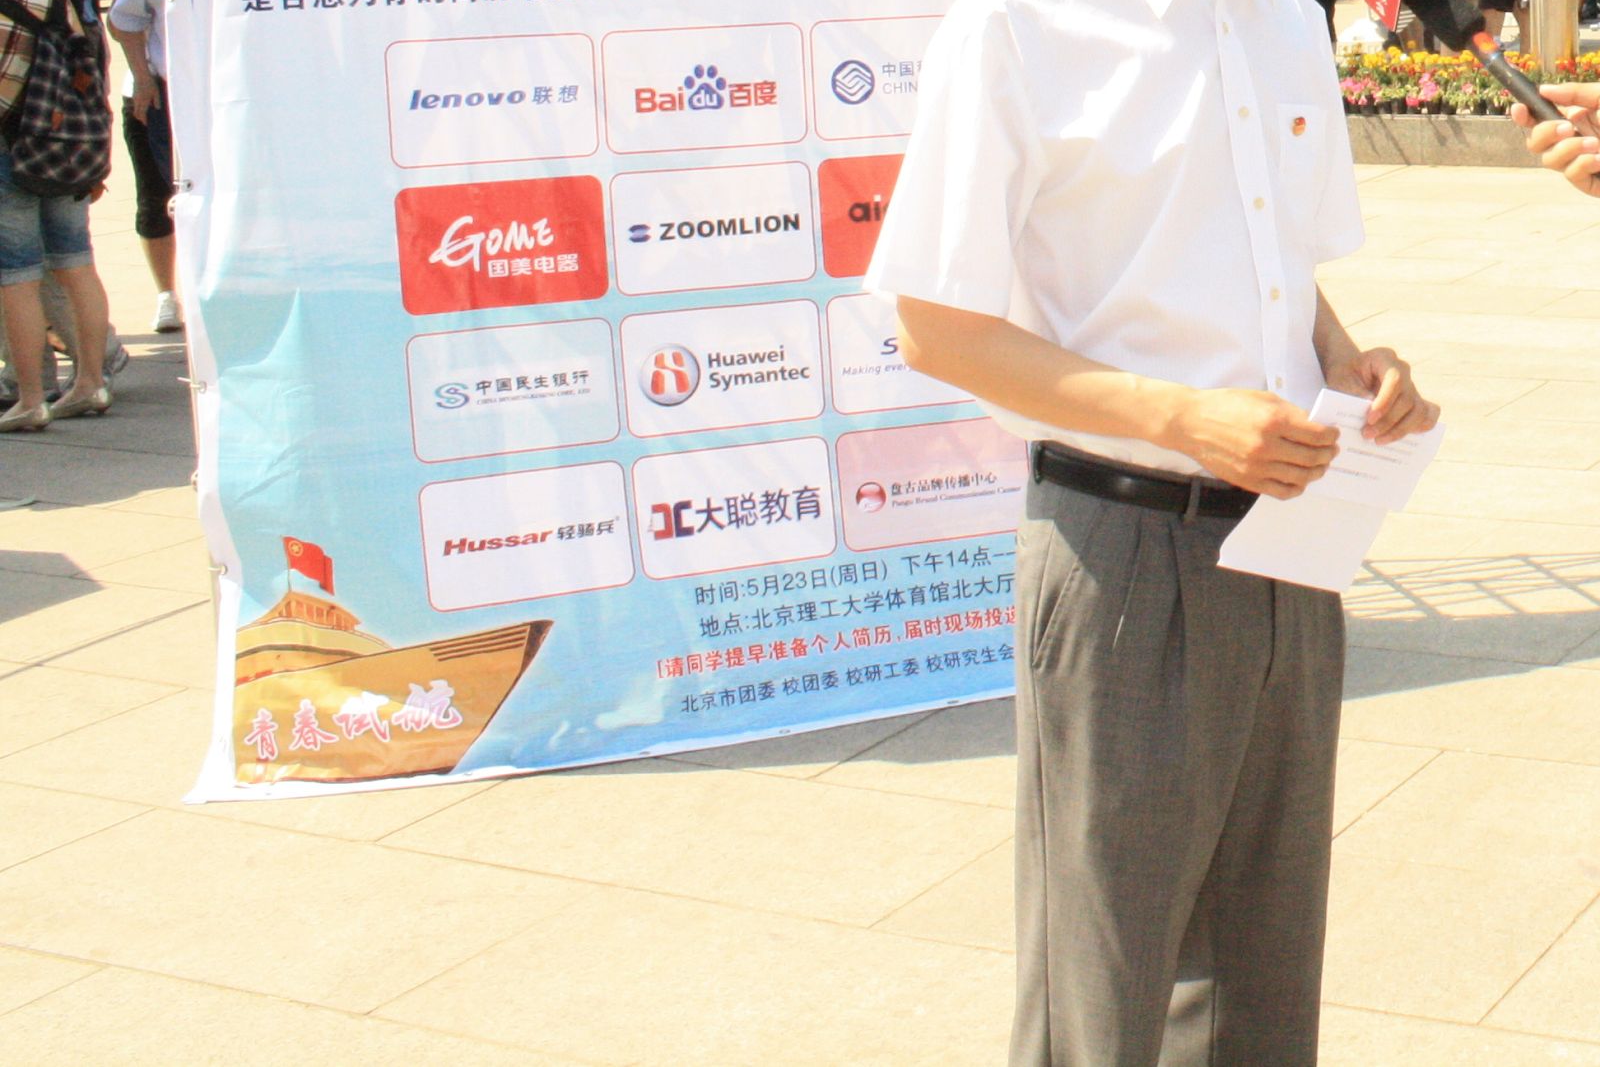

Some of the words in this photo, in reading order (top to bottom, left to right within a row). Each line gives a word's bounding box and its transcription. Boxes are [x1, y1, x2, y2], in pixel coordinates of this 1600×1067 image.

[409, 87, 526, 111] lenovo
[531, 84, 580, 105] 联想
[728, 80, 778, 108] 百度
[659, 213, 800, 243] ZOOMLION
[487, 253, 579, 278] 国美电器
[707, 345, 785, 367] Huawei
[842, 363, 881, 375] Making
[475, 370, 590, 396] 中国民生银行
[708, 365, 811, 390] Symantec
[891, 472, 997, 496] 盘古品牌传播中心
[695, 485, 822, 534] 大聪教育
[442, 529, 553, 557] Hussar
[556, 519, 616, 542] 轻骑兵
[681, 682, 776, 714] 北京市团委
[782, 671, 840, 697] 校团委
[846, 658, 920, 687] 校研工委
[926, 643, 1014, 673] 校研究生会
[244, 679, 463, 762] 青春试航
